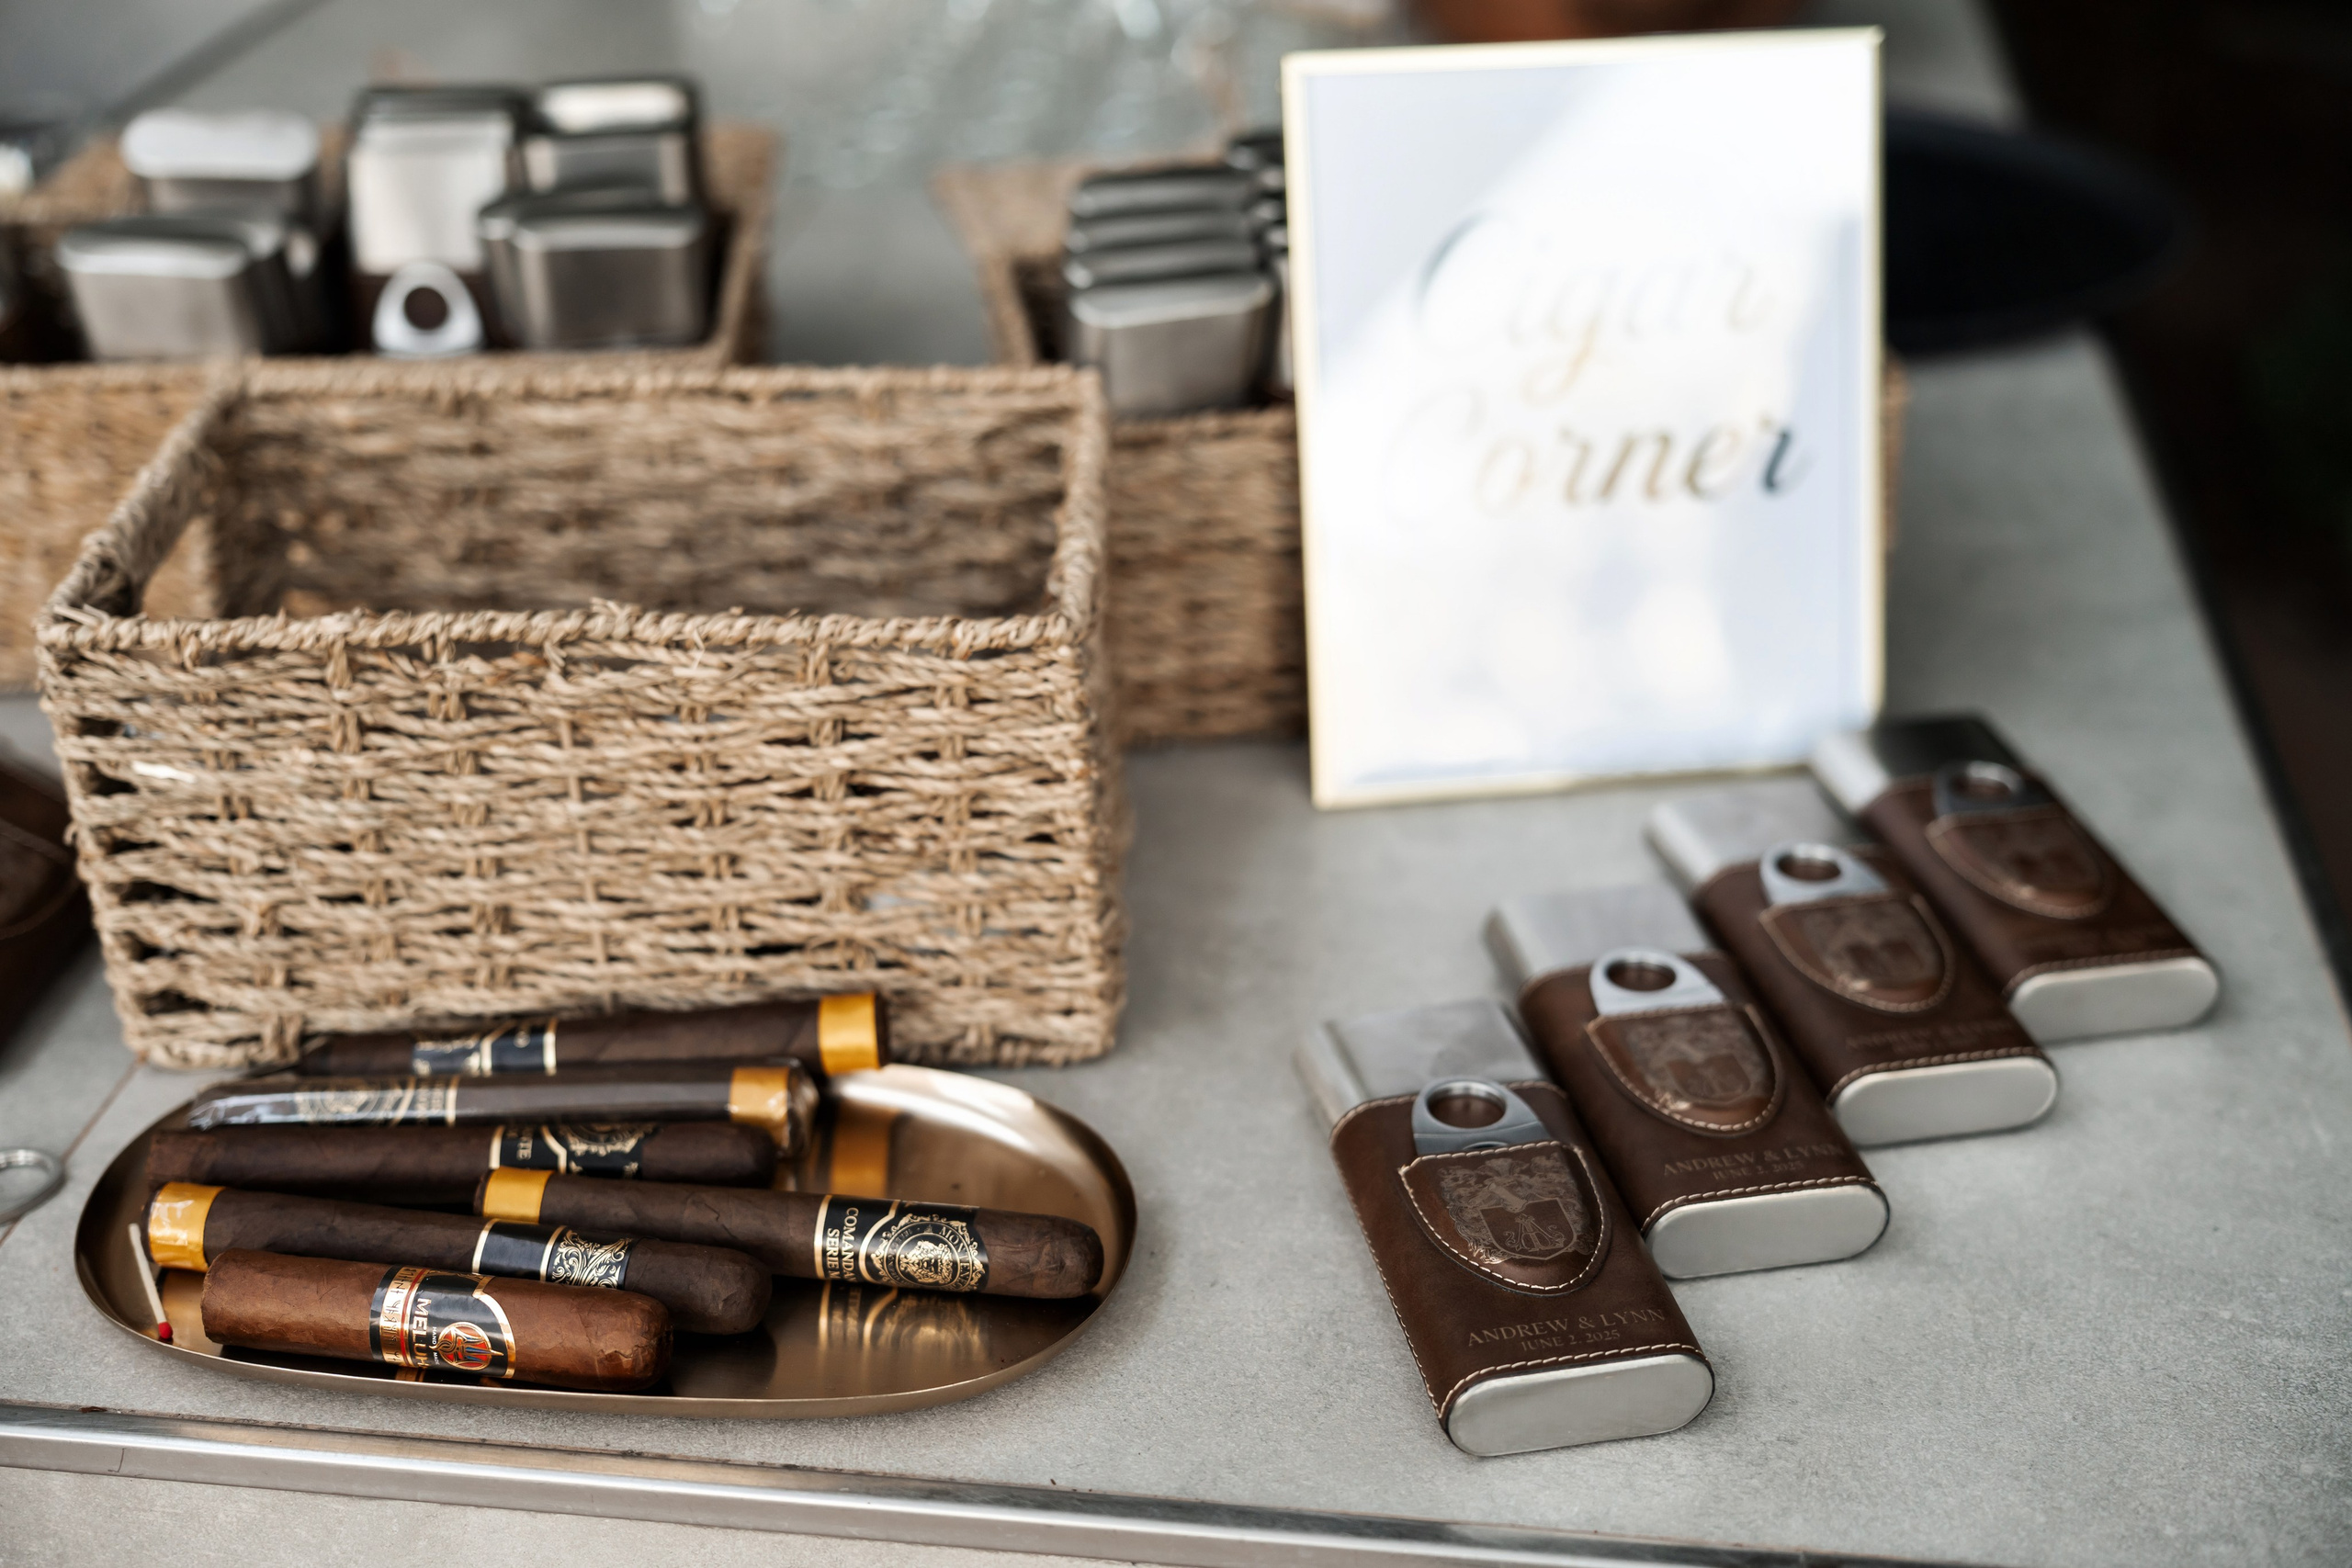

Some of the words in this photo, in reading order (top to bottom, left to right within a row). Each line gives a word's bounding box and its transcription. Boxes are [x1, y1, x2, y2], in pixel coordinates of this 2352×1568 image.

[1411, 207, 1775, 410] Cigar
[1381, 378, 1817, 531] Corner
[1664, 1151, 1756, 1177] ANDREW
[1763, 1149, 1781, 1162] &
[1783, 1143, 1845, 1158] LYNN
[1712, 1168, 1752, 1180] JUNE
[826, 1227, 840, 1270] SERIE
[1468, 1318, 1568, 1347] ANDREW
[1578, 1316, 1596, 1329] &
[1600, 1309, 1666, 1326] LYNN
[1521, 1334, 1565, 1351] JUNE
[1587, 1329, 1621, 1344] 2025
